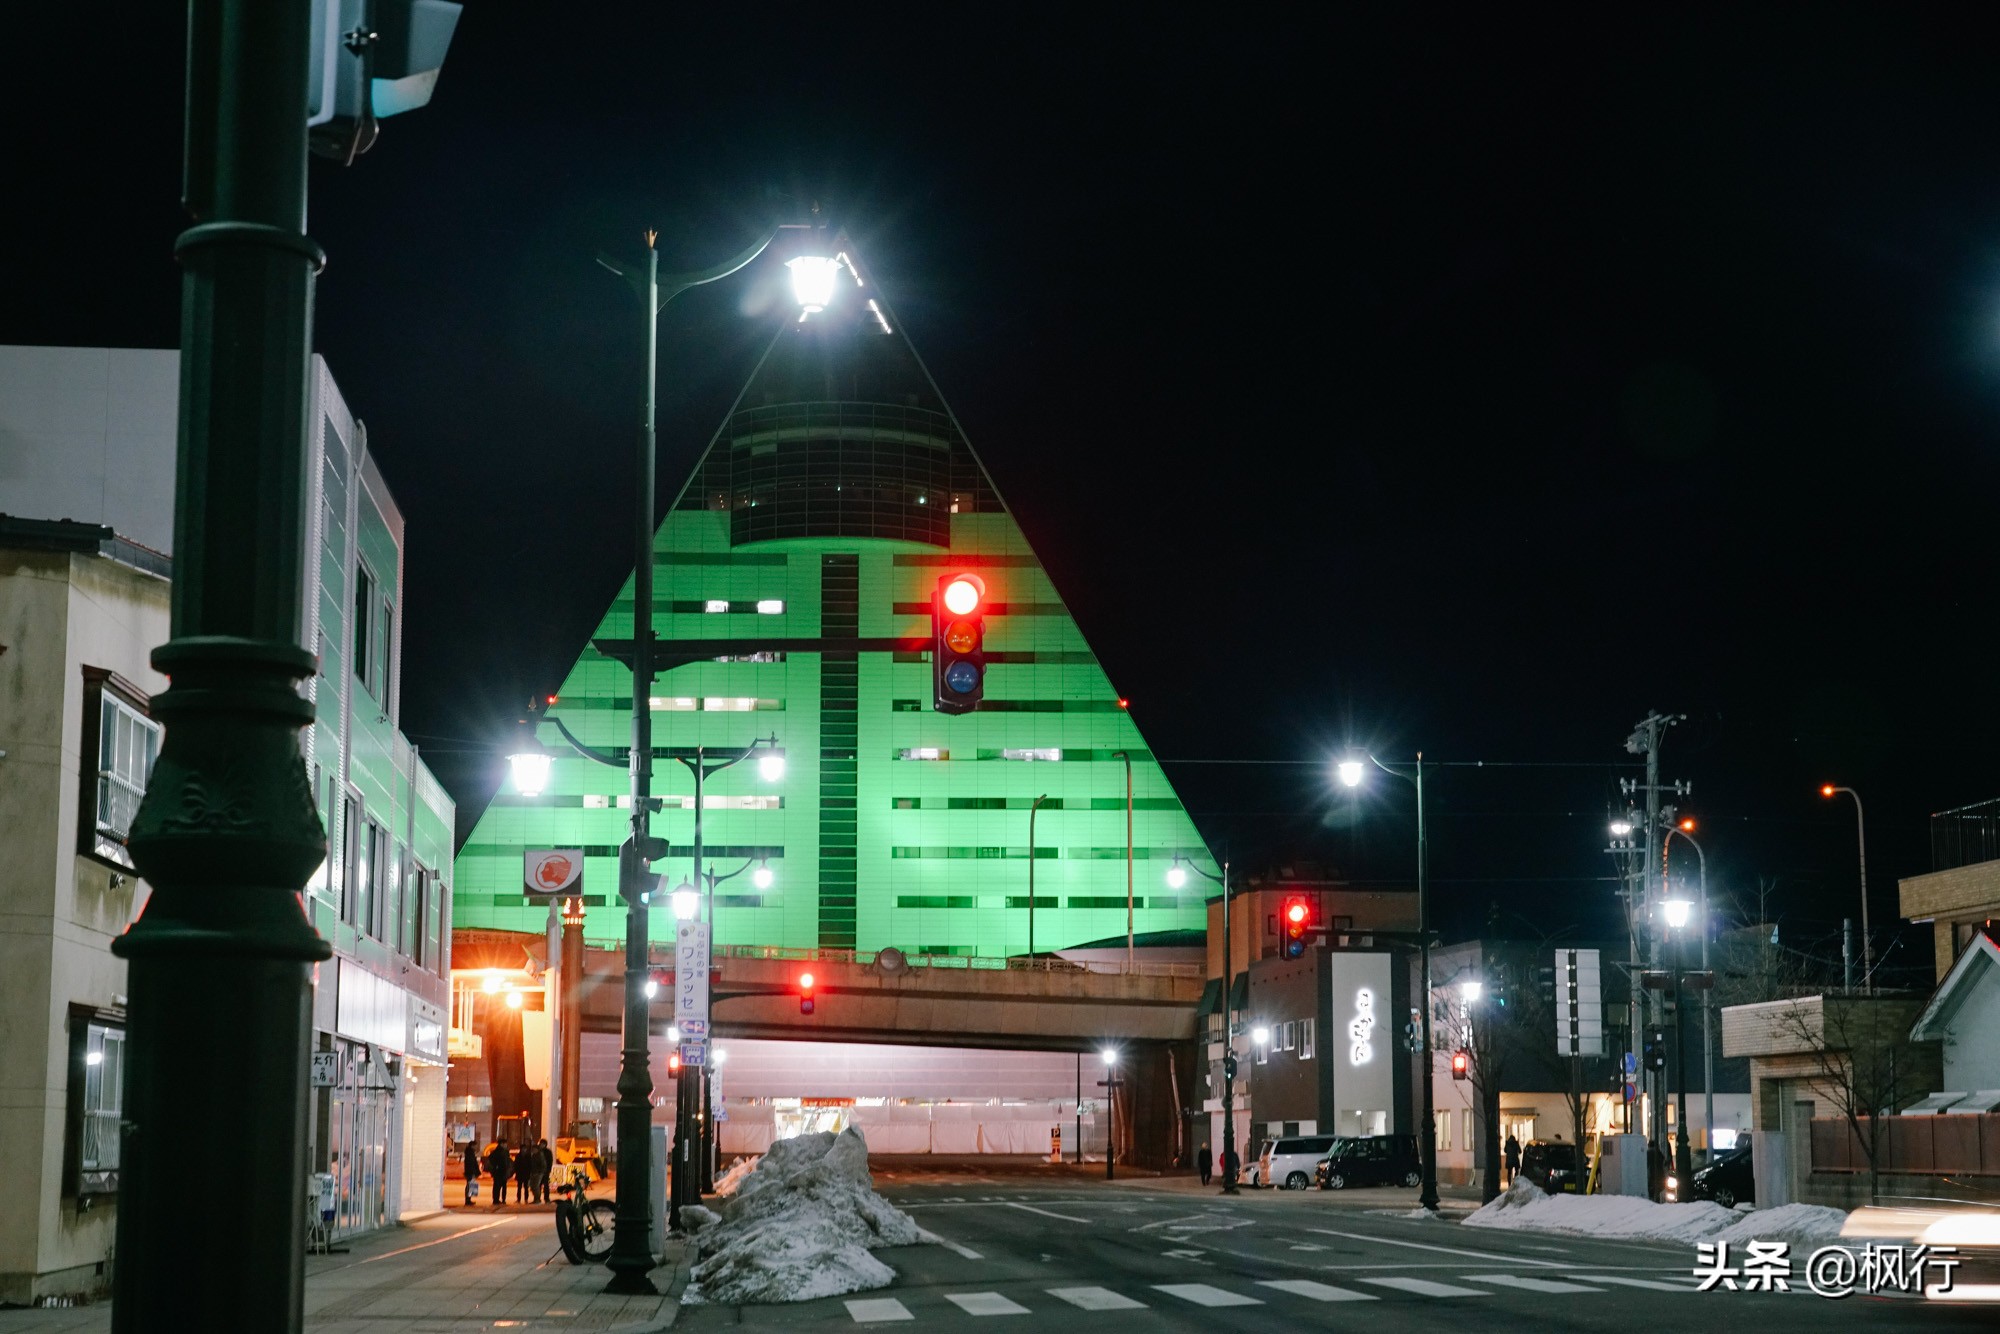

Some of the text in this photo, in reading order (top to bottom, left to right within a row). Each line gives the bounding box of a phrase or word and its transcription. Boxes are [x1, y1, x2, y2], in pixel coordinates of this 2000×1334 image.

[681, 946, 694, 1010] ワ・ラッセ
